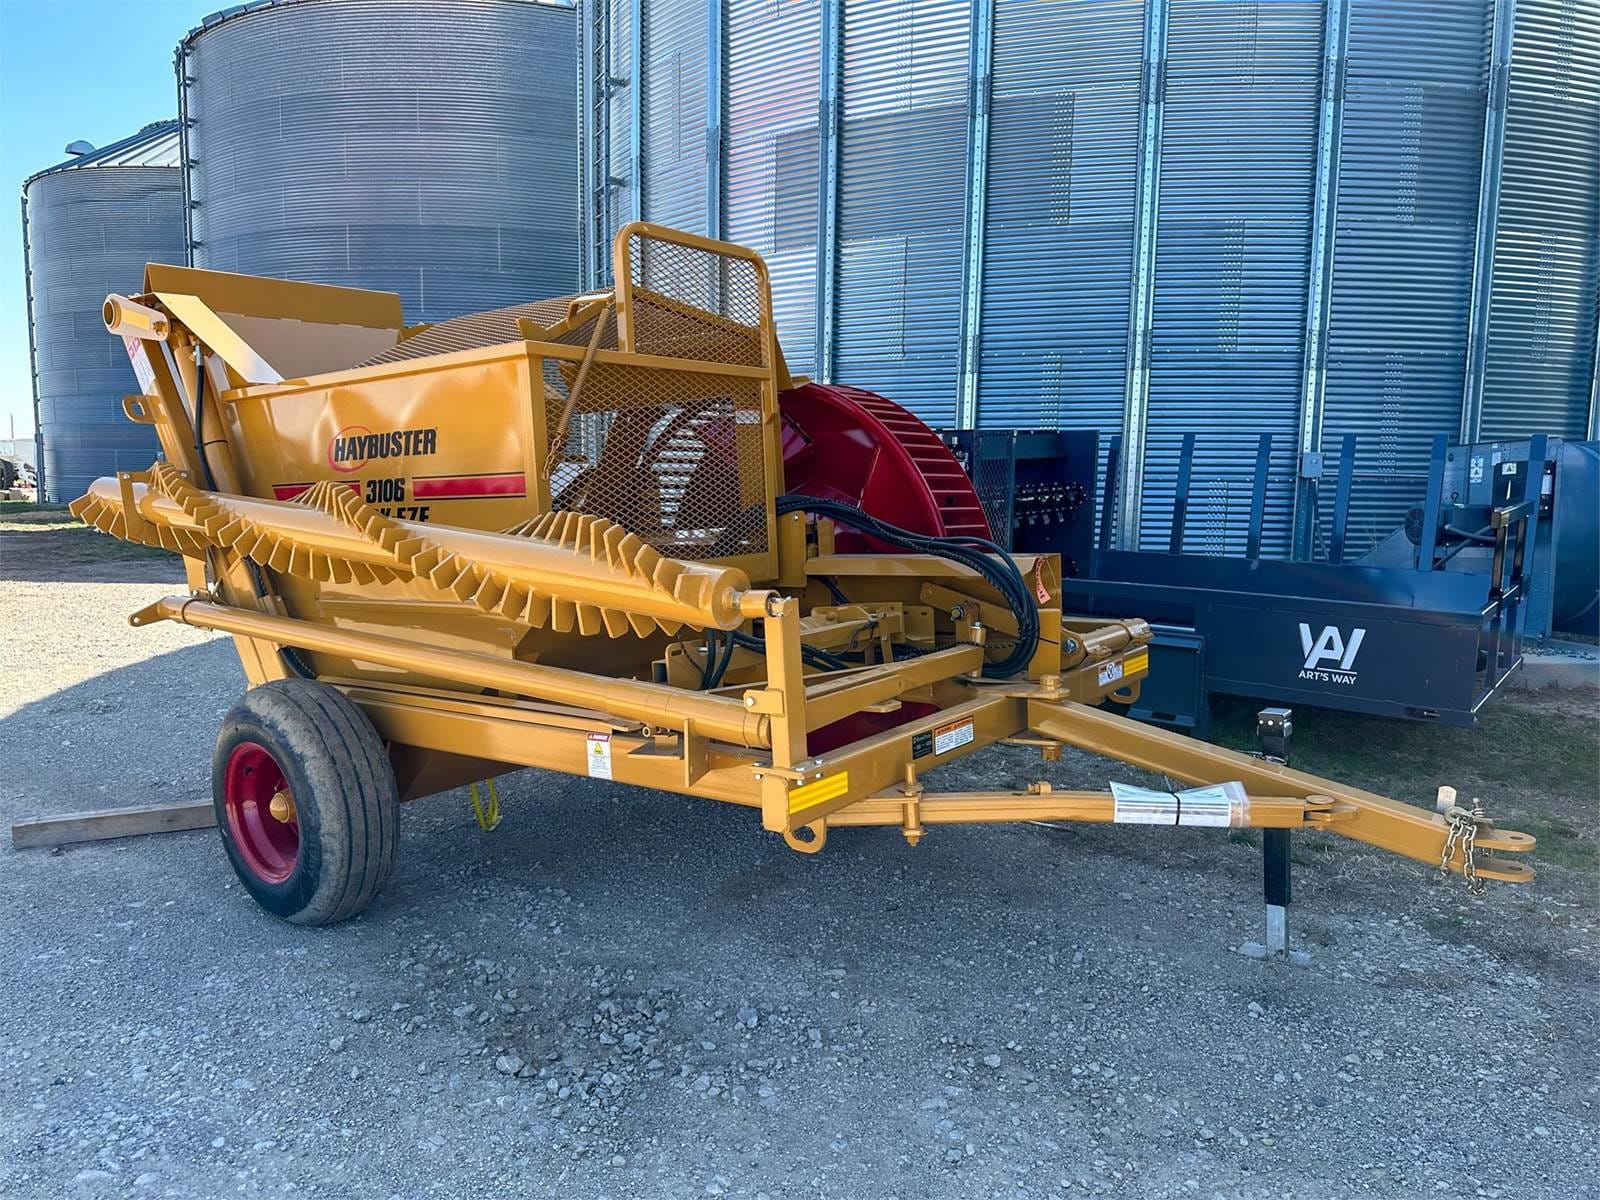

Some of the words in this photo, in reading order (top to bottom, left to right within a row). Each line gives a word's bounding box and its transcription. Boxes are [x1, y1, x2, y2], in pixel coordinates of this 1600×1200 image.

[334, 428, 437, 462] HAYBUSTER
[365, 478, 406, 504] 3106
[1298, 670, 1330, 682] ART'S
[1331, 673, 1357, 685] WAY
